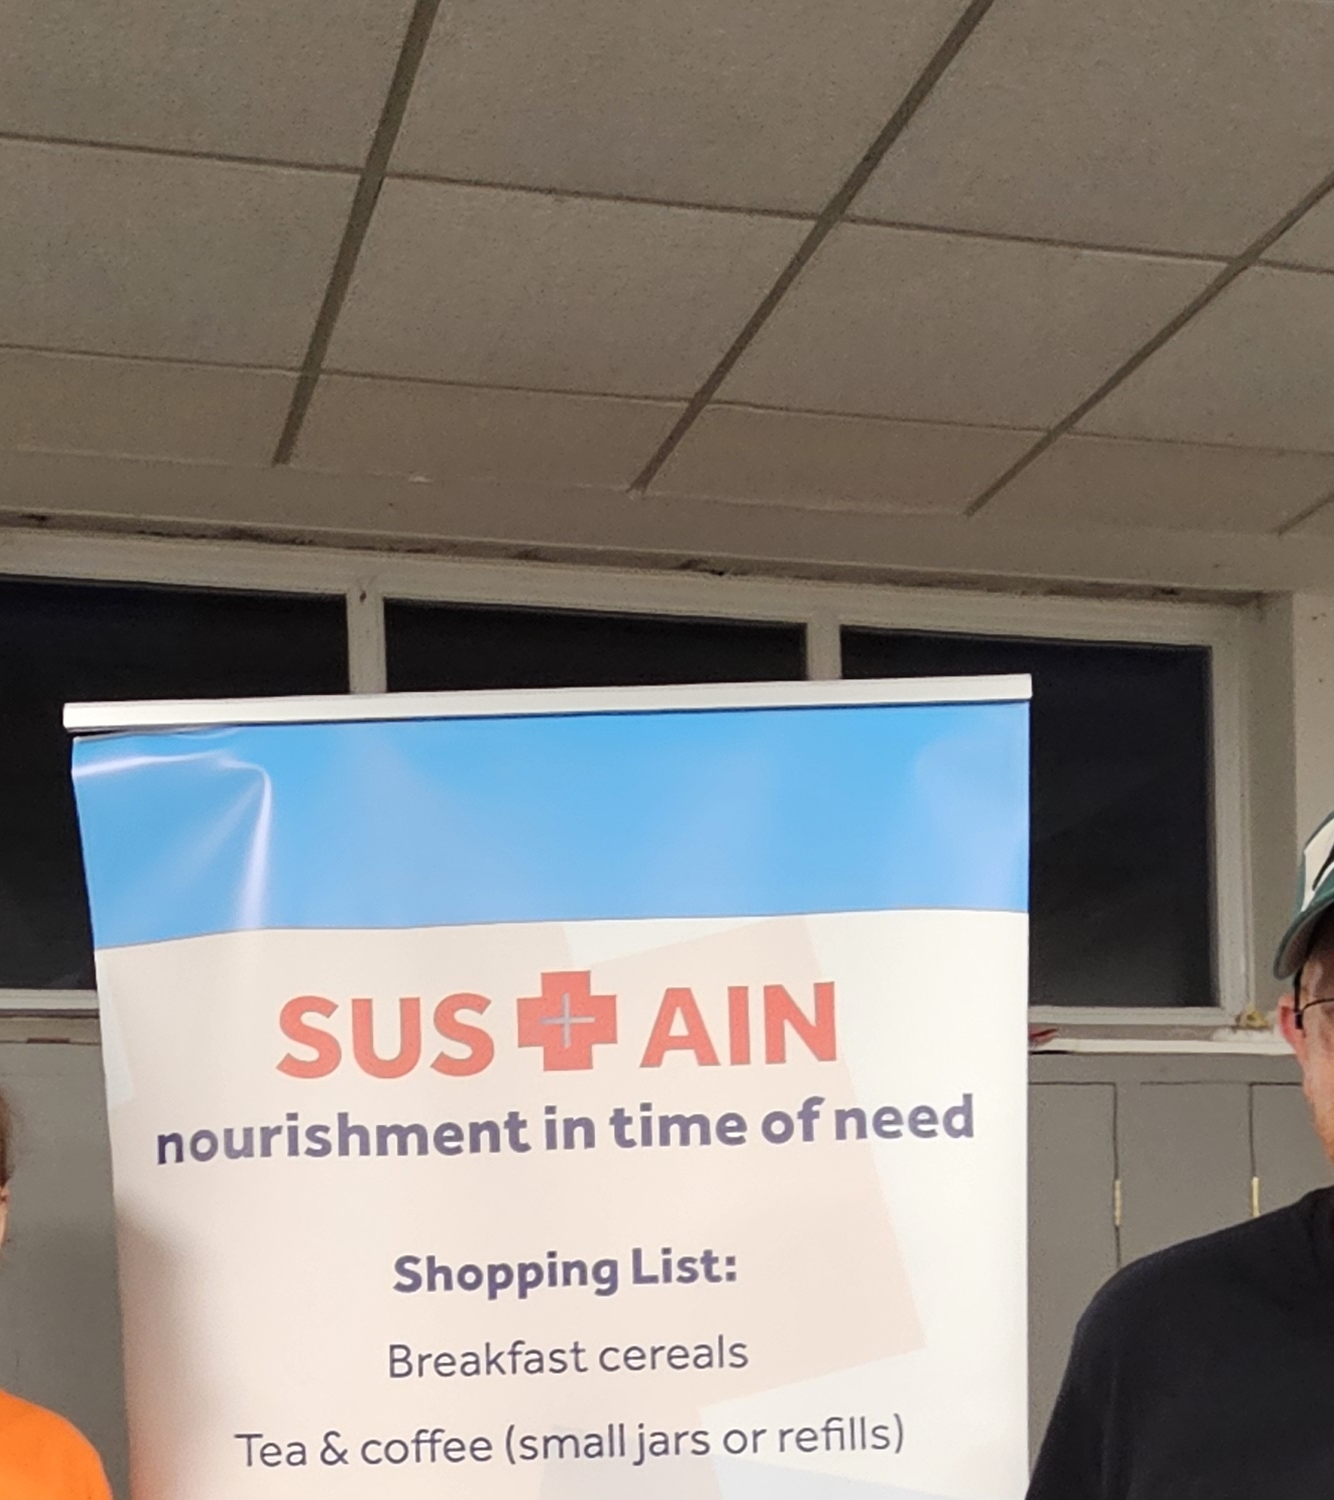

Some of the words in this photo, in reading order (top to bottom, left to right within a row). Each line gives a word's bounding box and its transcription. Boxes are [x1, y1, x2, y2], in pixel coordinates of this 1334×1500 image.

[157, 1111, 532, 1164] nourishment
[544, 1106, 596, 1151] in
[609, 1102, 748, 1149] time
[762, 1096, 826, 1145] of
[835, 1093, 975, 1141] need
[393, 1251, 619, 1301] Shopping
[631, 1246, 737, 1287] List:
[389, 1340, 588, 1379] Breakfast
[599, 1333, 749, 1373] cereals
[234, 1433, 308, 1468] Tea
[320, 1430, 350, 1467] &
[361, 1427, 494, 1465] coffee
[505, 1422, 625, 1465] (small
[631, 1422, 711, 1467] jars
[722, 1428, 768, 1455] or
[778, 1412, 904, 1455] refills)
